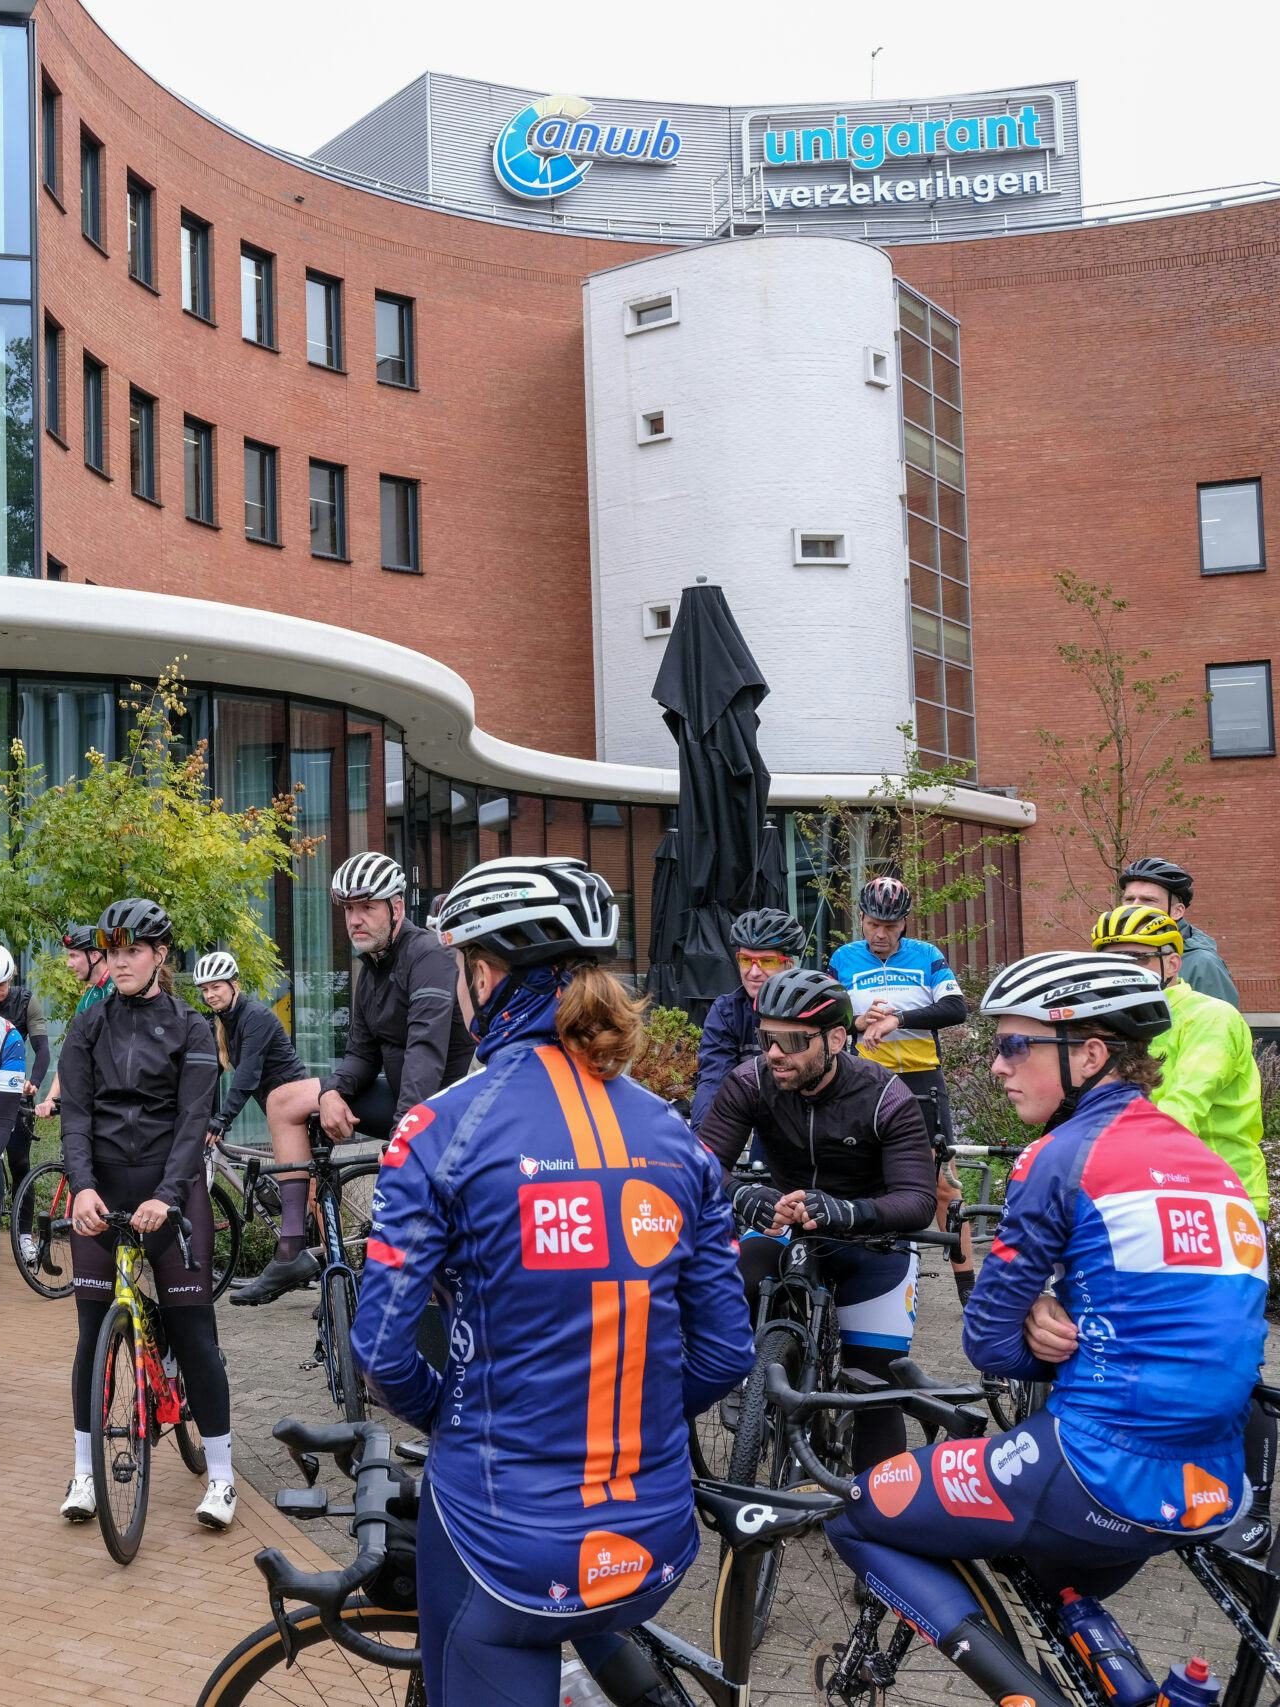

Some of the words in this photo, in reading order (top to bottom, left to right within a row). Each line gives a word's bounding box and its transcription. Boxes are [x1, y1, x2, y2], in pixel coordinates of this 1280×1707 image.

[535, 117, 683, 161] anwb
[764, 105, 1043, 172] unigarant
[768, 170, 1045, 211] verzekeringen
[860, 972, 918, 986] unigarant
[1043, 982, 1092, 1002] LAZER
[540, 1158, 574, 1171] Nalini
[533, 1197, 592, 1226] PIC
[1170, 1209, 1209, 1231] PIC
[451, 1364, 466, 1426] more
[940, 1448, 977, 1474] PIC
[873, 1468, 914, 1490] postnl
[1085, 1511, 1132, 1534] Nalini
[1242, 1523, 1264, 1542] GripGrab
[587, 1554, 644, 1585] postnl
